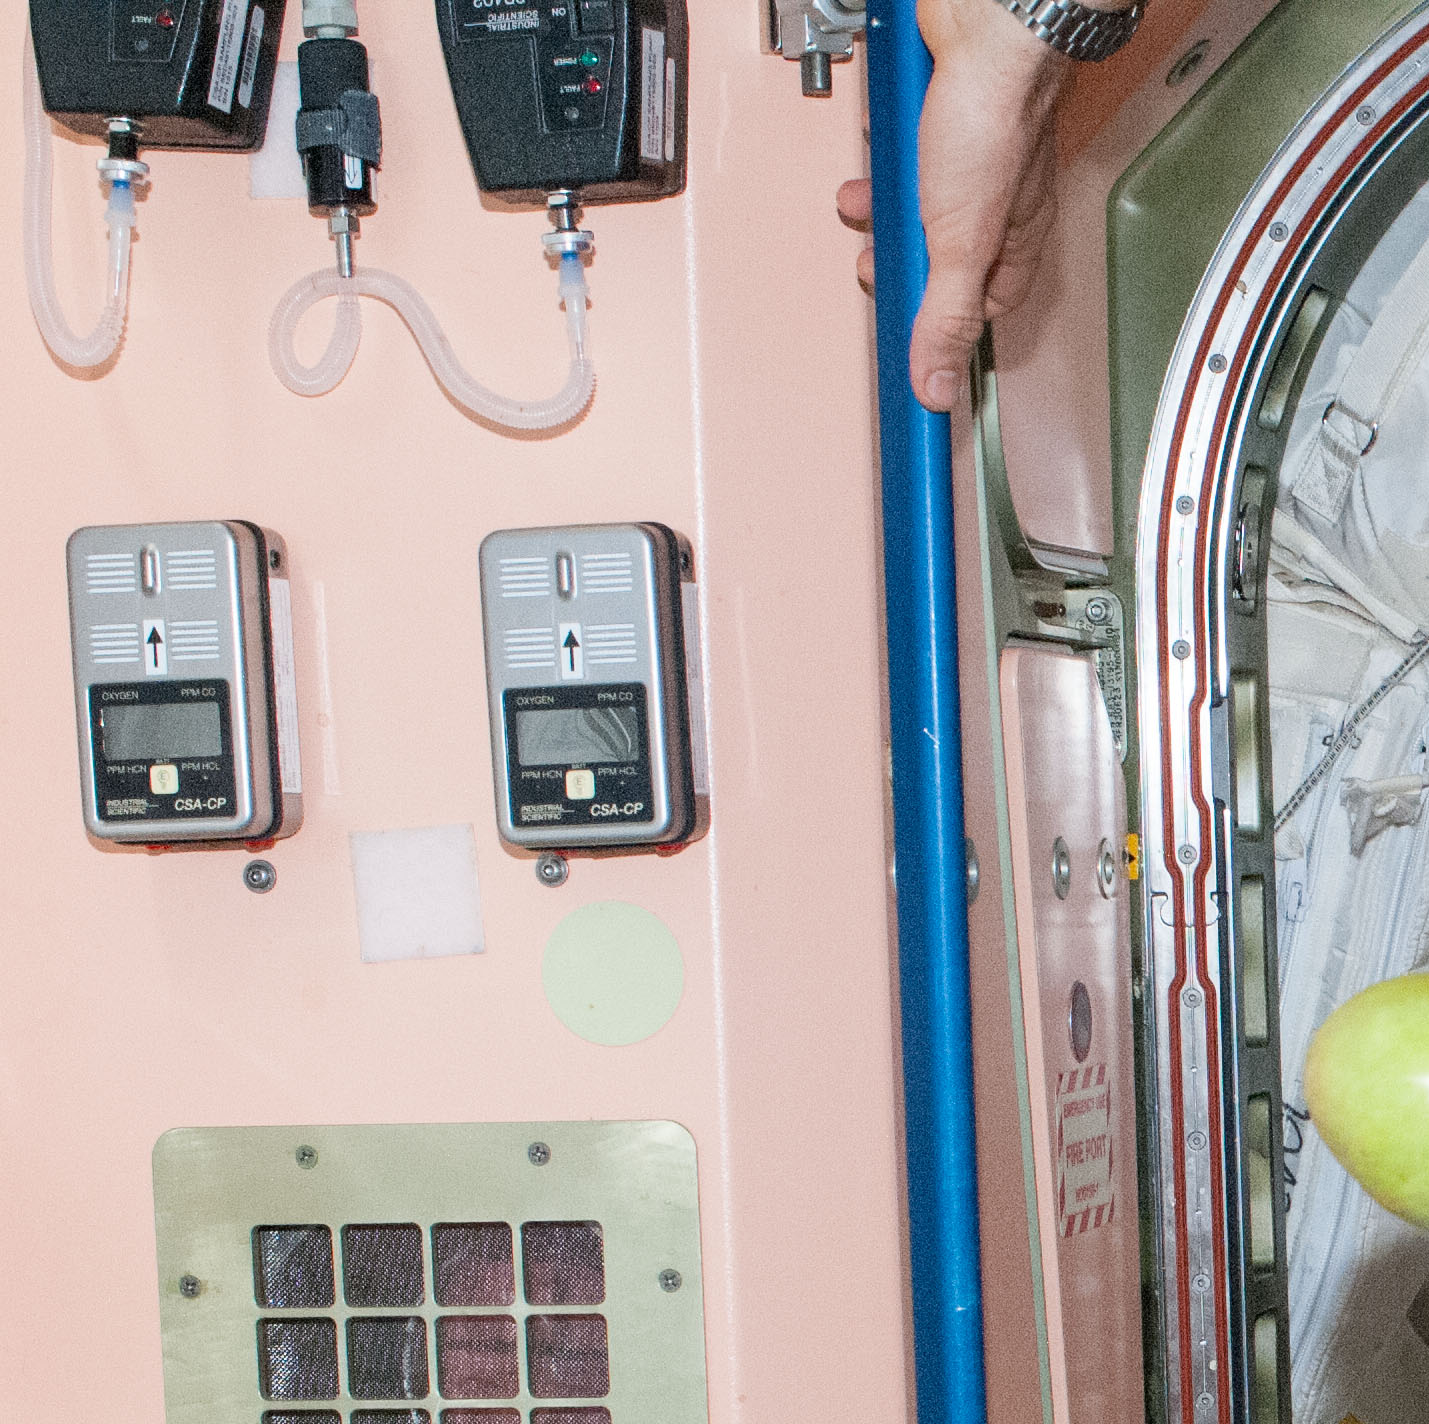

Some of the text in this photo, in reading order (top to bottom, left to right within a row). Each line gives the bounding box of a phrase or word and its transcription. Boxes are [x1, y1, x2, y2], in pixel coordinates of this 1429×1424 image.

[551, 8, 566, 16] ON
[102, 691, 139, 700] OXYGEN
[181, 687, 216, 697] PPM CO
[597, 692, 633, 701] PPM CO
[516, 695, 554, 705] OXYGEN
[107, 764, 147, 774] PPM HCN
[182, 763, 200, 771] PPM
[521, 770, 562, 779] PPM HCN
[598, 768, 616, 776] PPM
[174, 797, 227, 811] CSA-CP
[590, 802, 643, 816] CSA-CP
[1066, 1134, 1106, 1168] FIRE PORT
